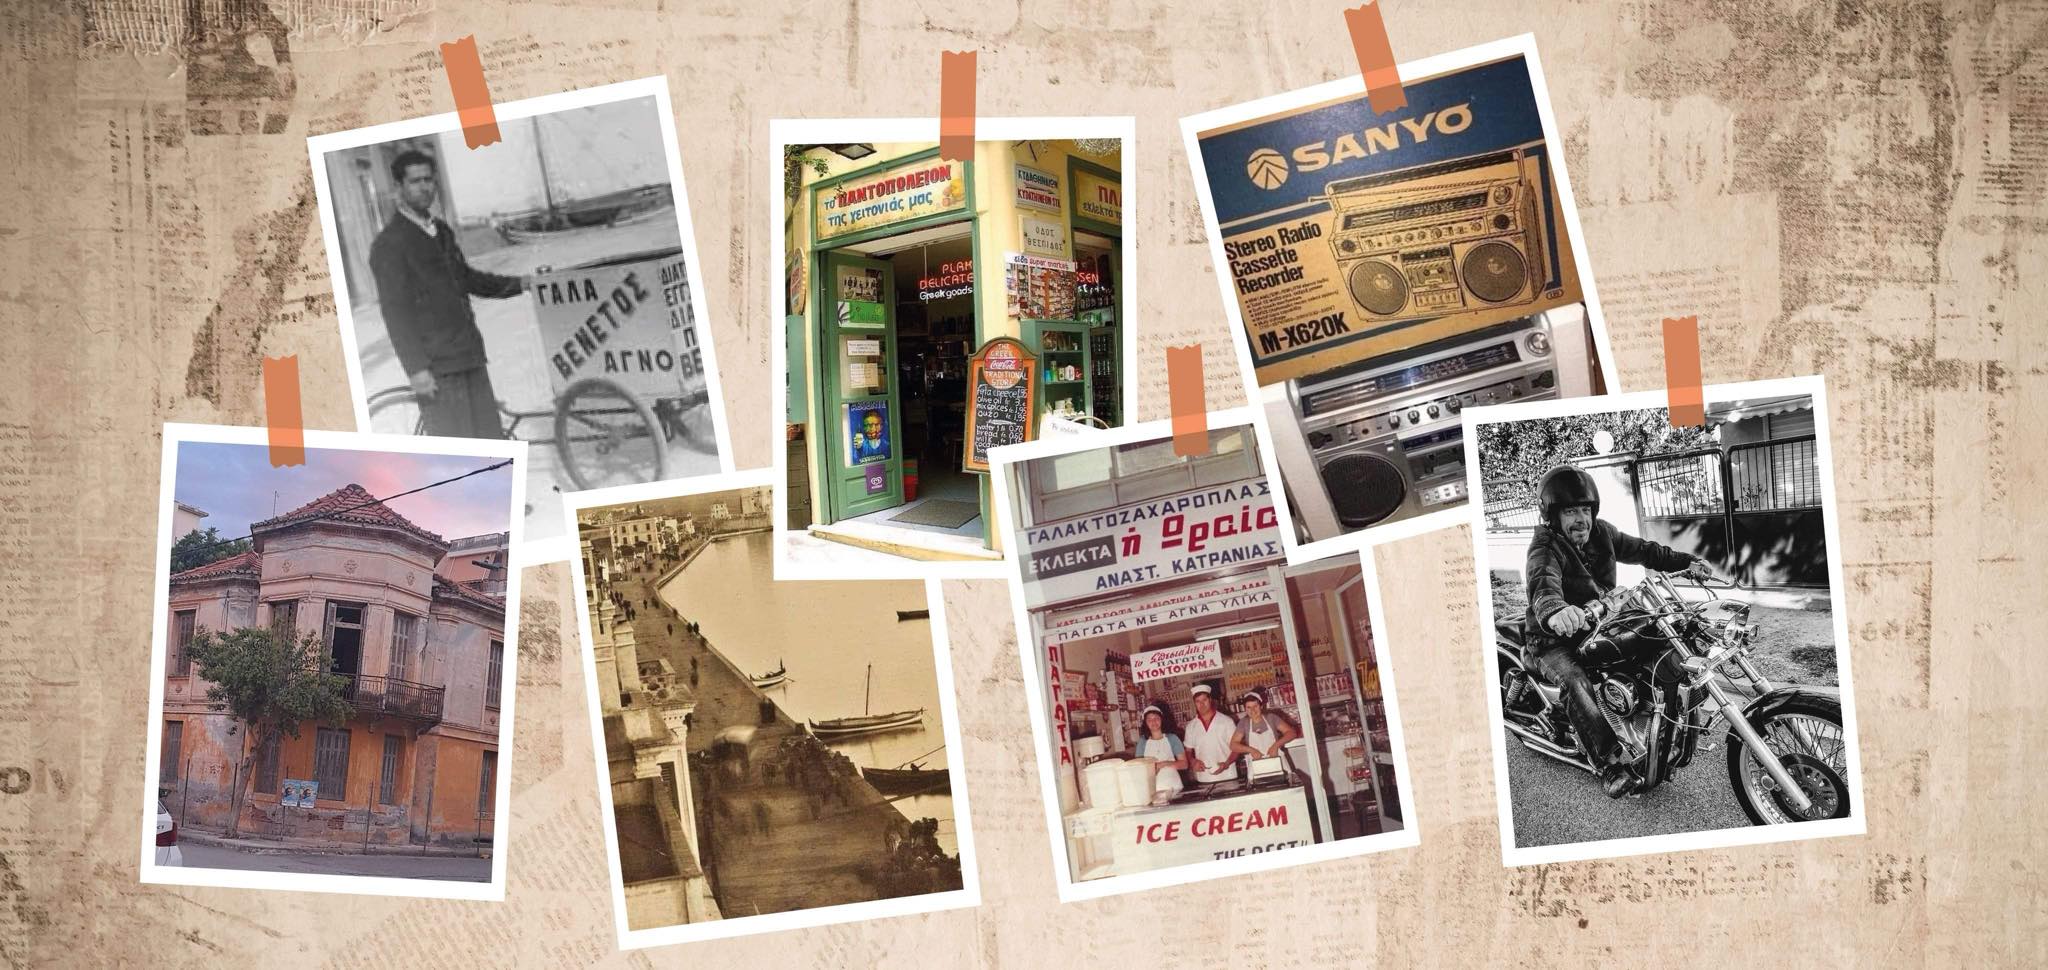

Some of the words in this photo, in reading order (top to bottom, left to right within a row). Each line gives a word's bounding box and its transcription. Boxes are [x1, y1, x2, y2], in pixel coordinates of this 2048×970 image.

[1292, 102, 1473, 174] SANYO
[827, 213, 847, 227] της
[850, 196, 904, 224] γειτονιάς
[908, 192, 933, 212] μας
[1098, 185, 1122, 208] ΠΛ
[1035, 226, 1055, 237] ΟΔΟΣ
[1223, 235, 1277, 261] Stereo
[1277, 221, 1322, 247] Radio
[1229, 248, 1298, 278] Cassette
[1236, 265, 1304, 295] Recorder
[536, 278, 599, 306] ΓΑΛΑ
[919, 287, 945, 300] Greek
[552, 272, 648, 381] ΒΕΝΕΤΟΣ
[1258, 311, 1351, 355] M-X620K
[603, 349, 674, 374] ΑΓΝΟ
[1027, 481, 1271, 545] ΓΑΛΑΚΤΟΖΑΧΑΡΟΠΛΑΣ
[1028, 544, 1112, 575] ΕΚΛΕΚΤΑ
[1096, 564, 1161, 591] ΑΝΑΣΤ.
[1172, 540, 1279, 574] ΚΑΤΡΑΝΙΑΣ
[1058, 620, 1127, 642] ΠΑΓΩΤΑ
[1135, 614, 1159, 627] ΜΕ
[1168, 603, 1210, 619] ΑΓΝΑ
[1137, 659, 1218, 680] ΝΤΟΝΤΟΥΡΜΑ
[1048, 645, 1072, 766] ΠΑΓΩΤΑ
[1136, 820, 1181, 844] ICE
[1191, 805, 1289, 838] CREAM
